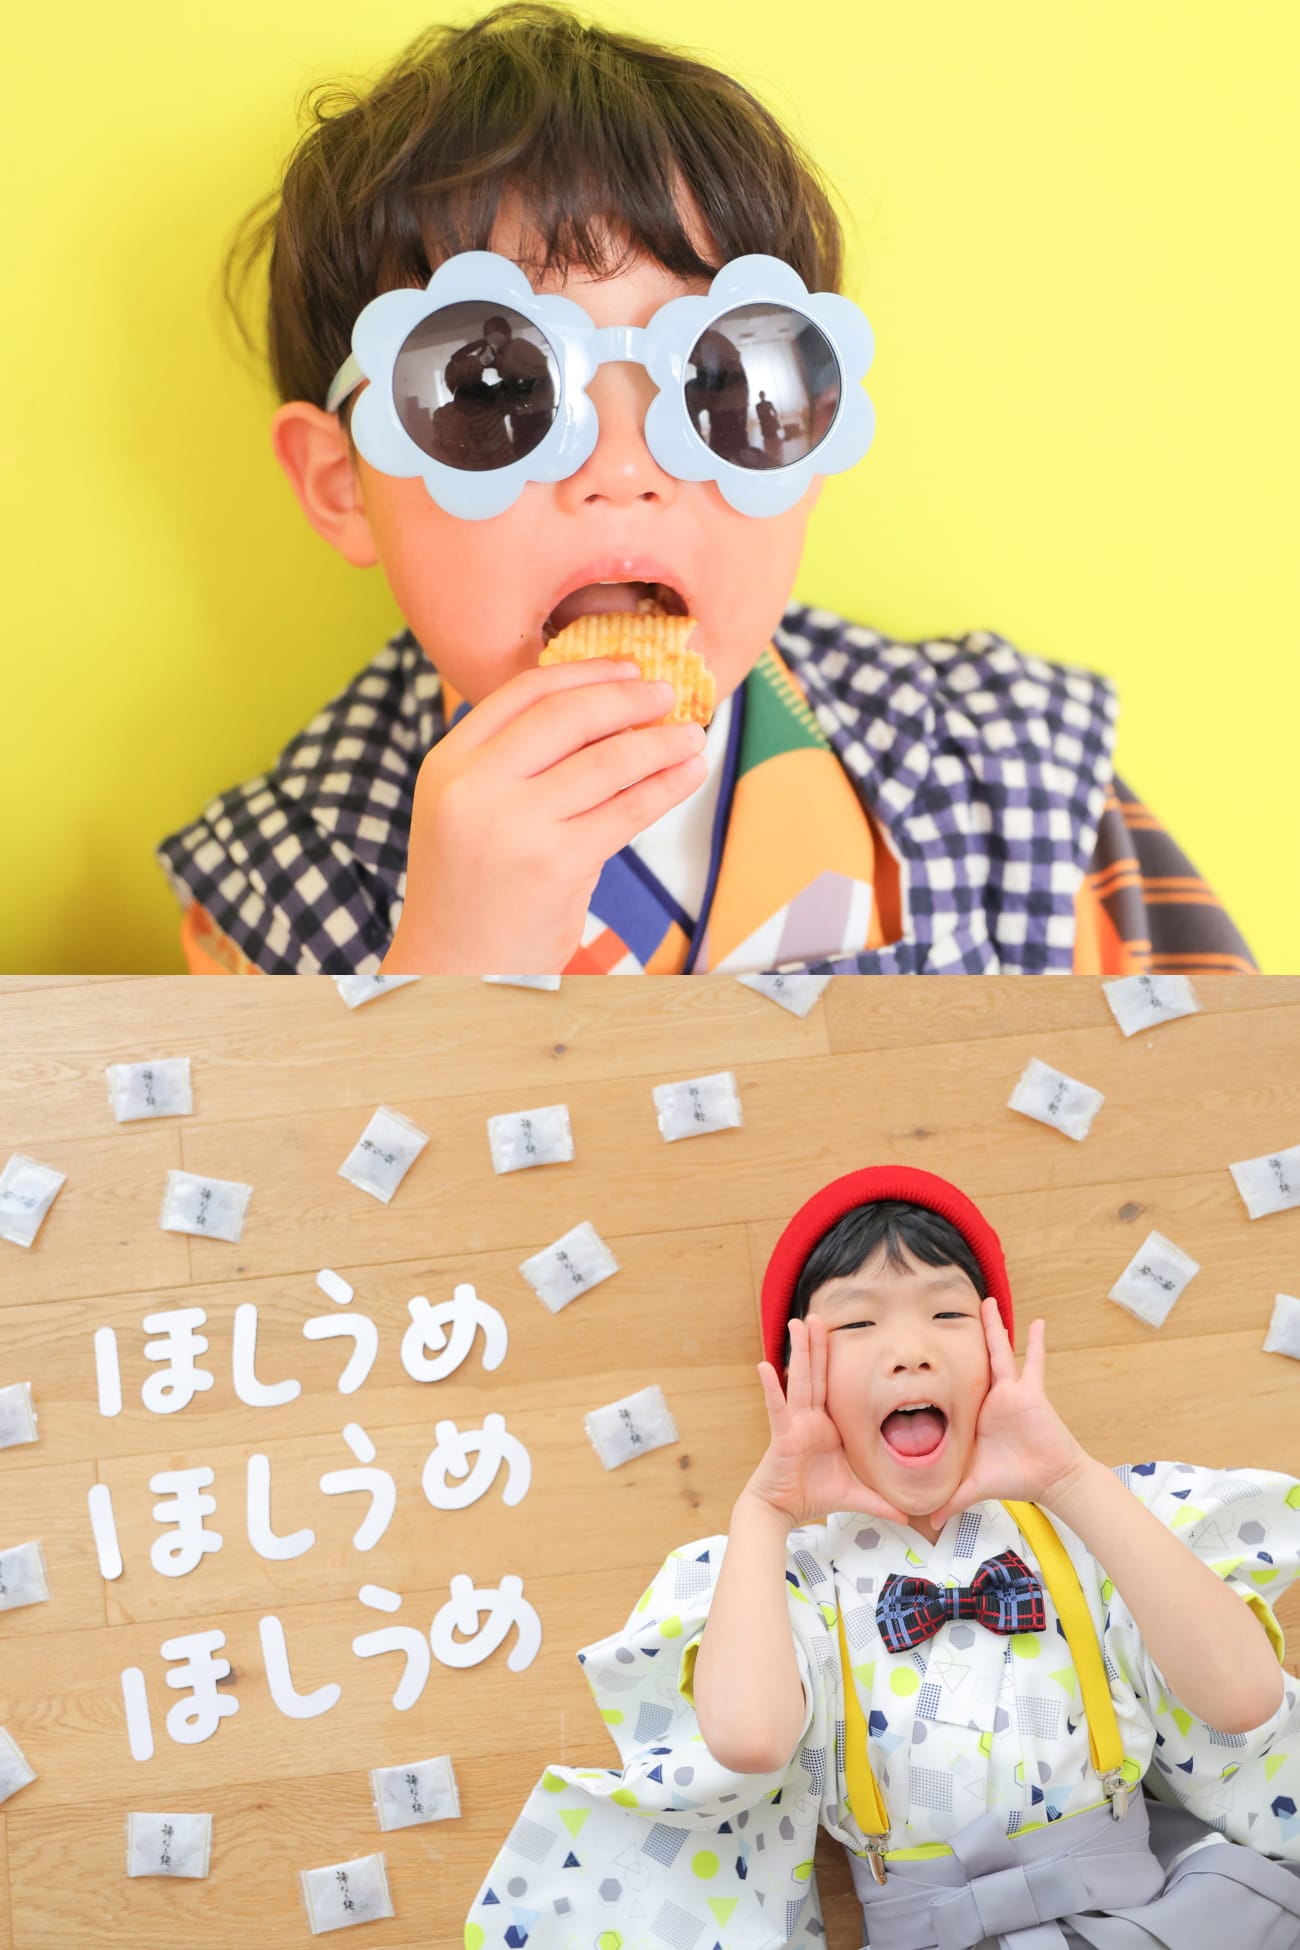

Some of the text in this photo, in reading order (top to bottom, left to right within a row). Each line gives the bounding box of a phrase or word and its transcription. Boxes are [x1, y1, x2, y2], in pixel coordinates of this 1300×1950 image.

[94, 1269, 508, 1418] ほしうめ
[87, 1413, 531, 1581] ほしうめ
[120, 1574, 542, 1762] ほしうめ
